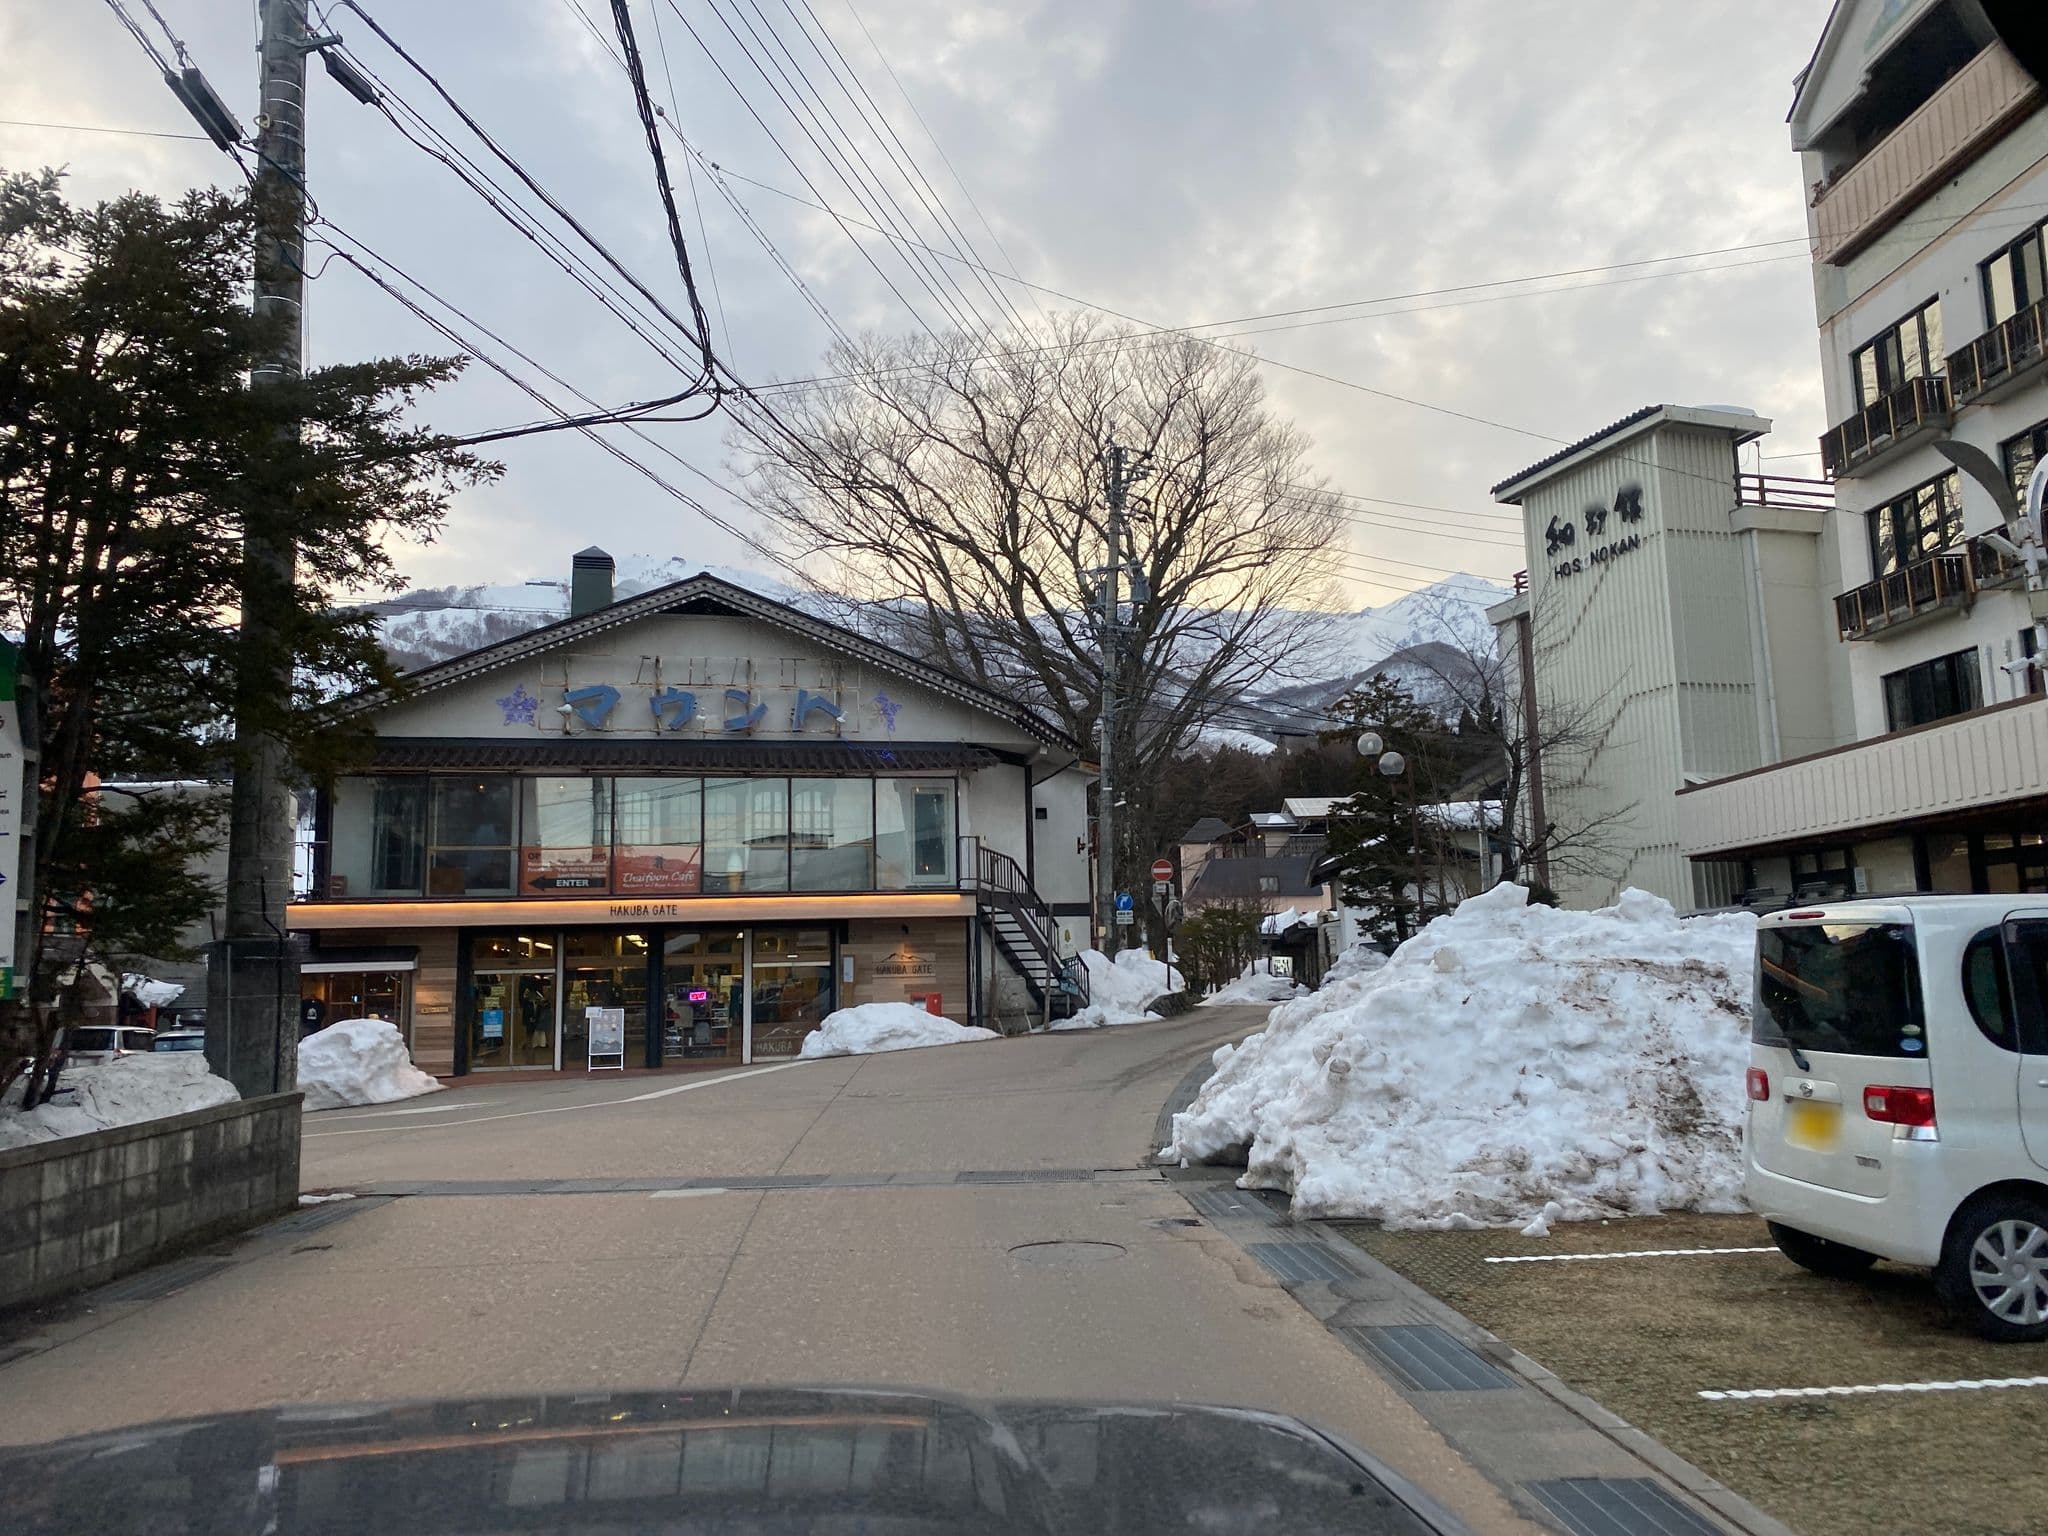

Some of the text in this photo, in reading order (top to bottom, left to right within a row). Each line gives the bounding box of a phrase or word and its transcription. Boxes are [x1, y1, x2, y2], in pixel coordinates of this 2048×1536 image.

[563, 684, 843, 732] マウント
[556, 879, 589, 887] ENTER
[610, 904, 678, 916] HAKUBA GATE
[876, 963, 933, 975] HAKUBA GATE
[756, 1040, 793, 1053] HAKUBA
